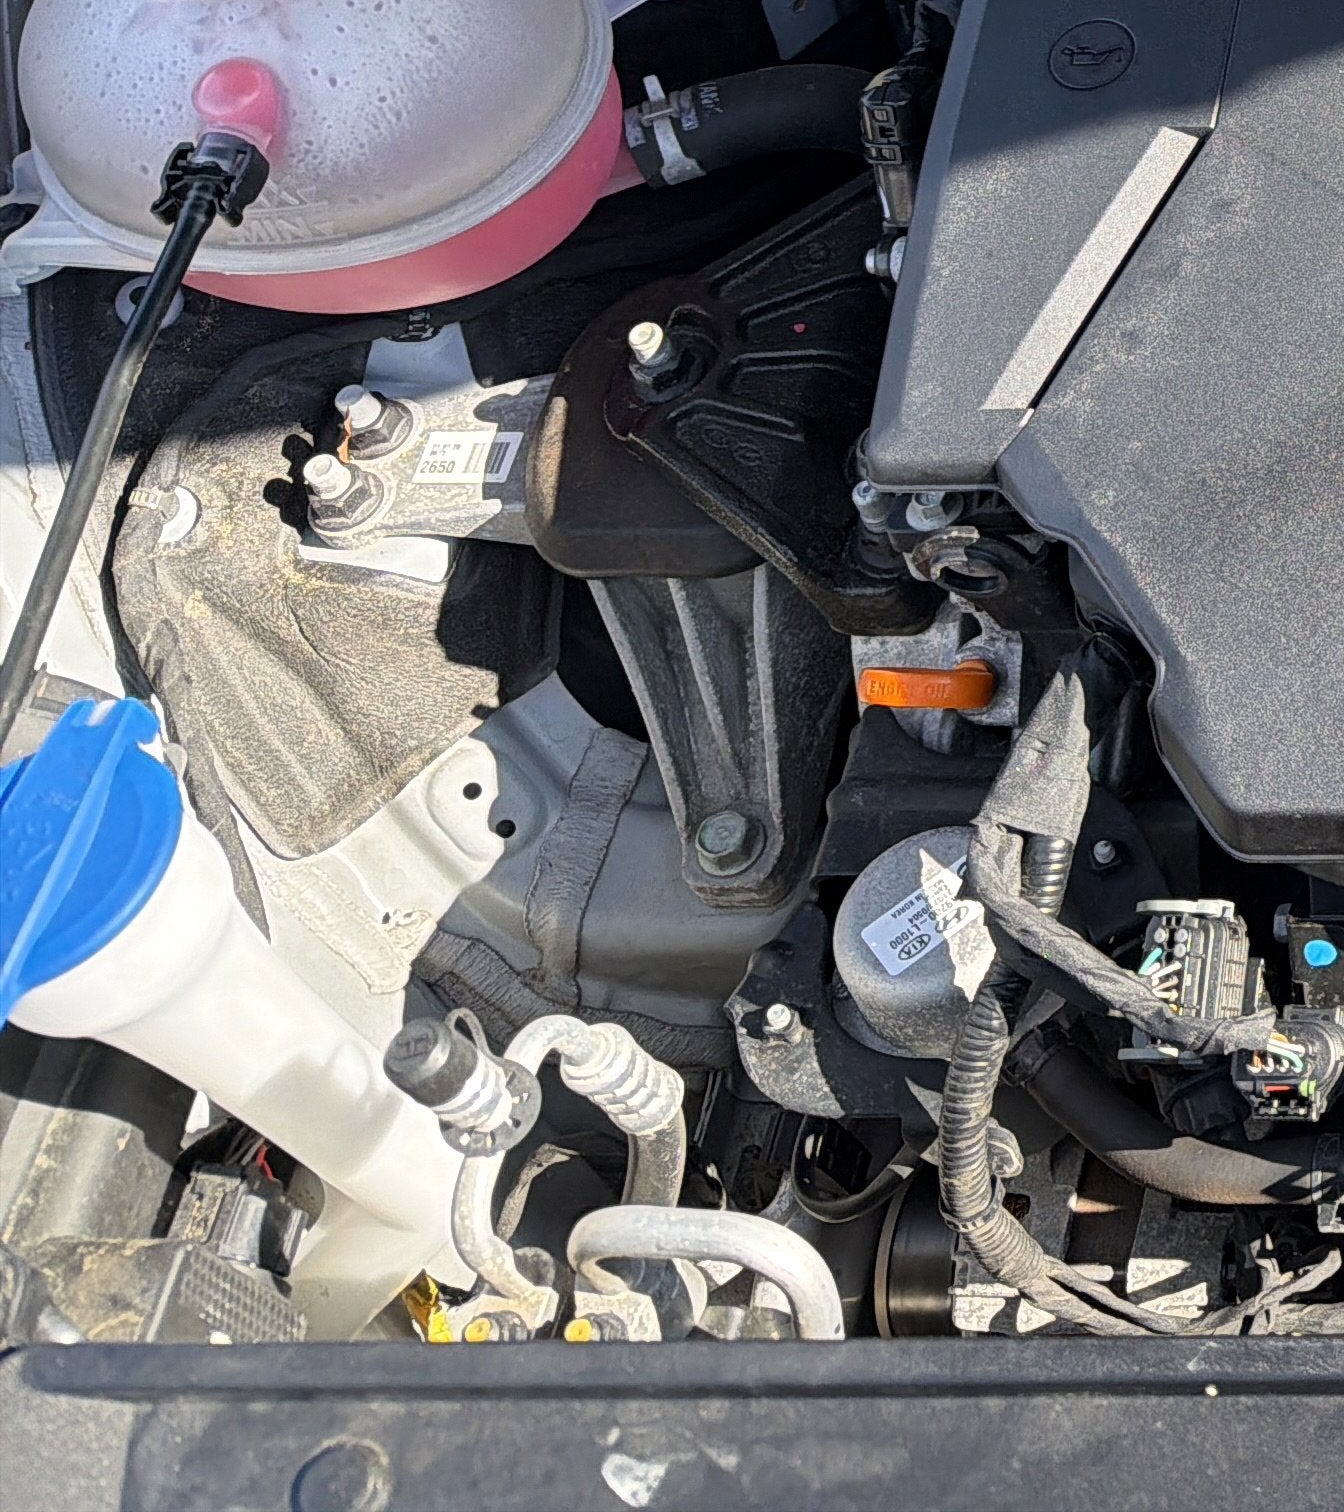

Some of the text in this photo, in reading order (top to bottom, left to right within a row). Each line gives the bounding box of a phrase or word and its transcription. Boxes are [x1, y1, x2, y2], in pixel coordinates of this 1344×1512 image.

[240, 218, 313, 243] MIN
[420, 460, 456, 474] 2650
[891, 899, 916, 920] KOREA
[901, 935, 928, 959] KIA
